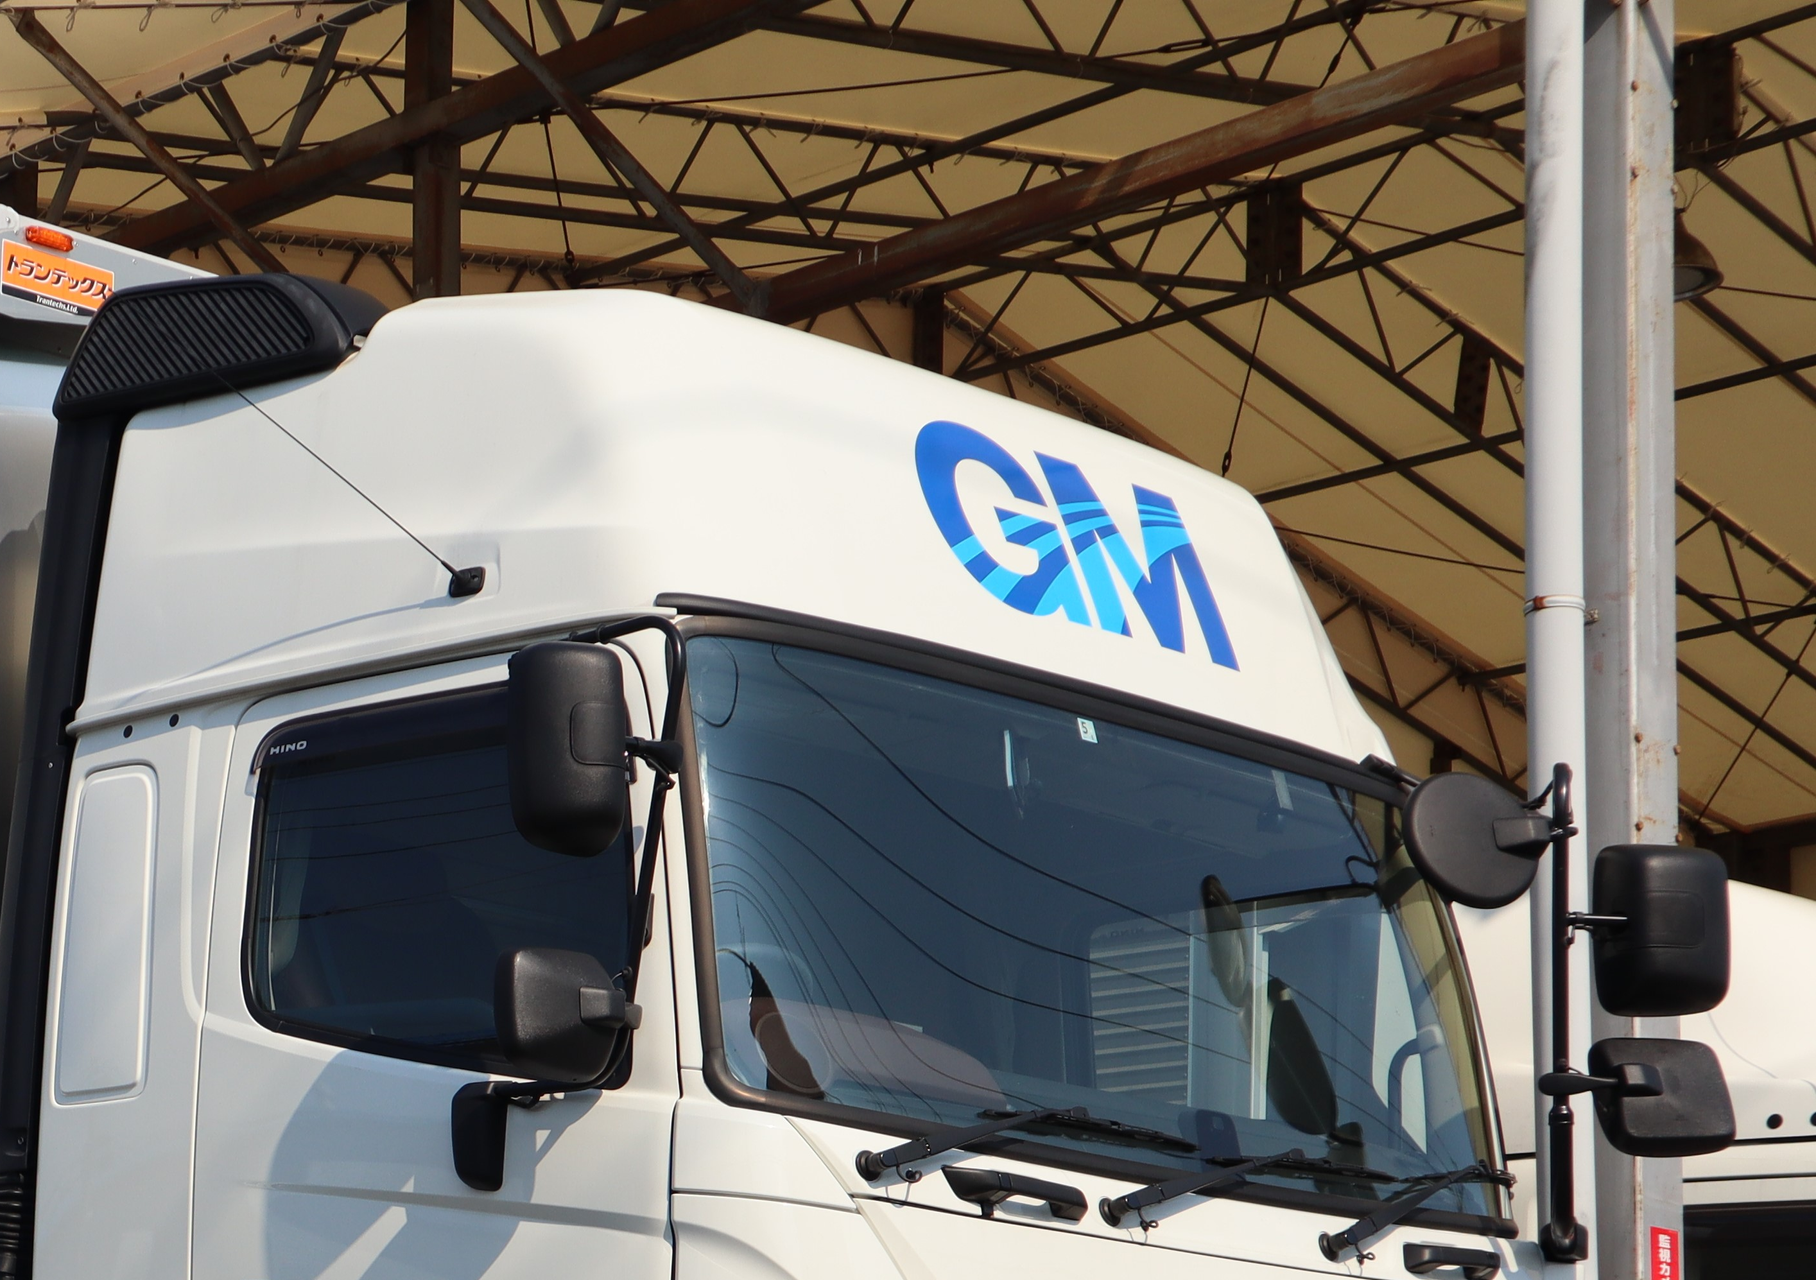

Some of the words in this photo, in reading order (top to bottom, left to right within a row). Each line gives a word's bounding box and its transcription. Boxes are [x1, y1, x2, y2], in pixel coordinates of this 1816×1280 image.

[7, 254, 109, 300] トランテックス
[915, 420, 1241, 672] GM
[269, 740, 307, 755] HINO
